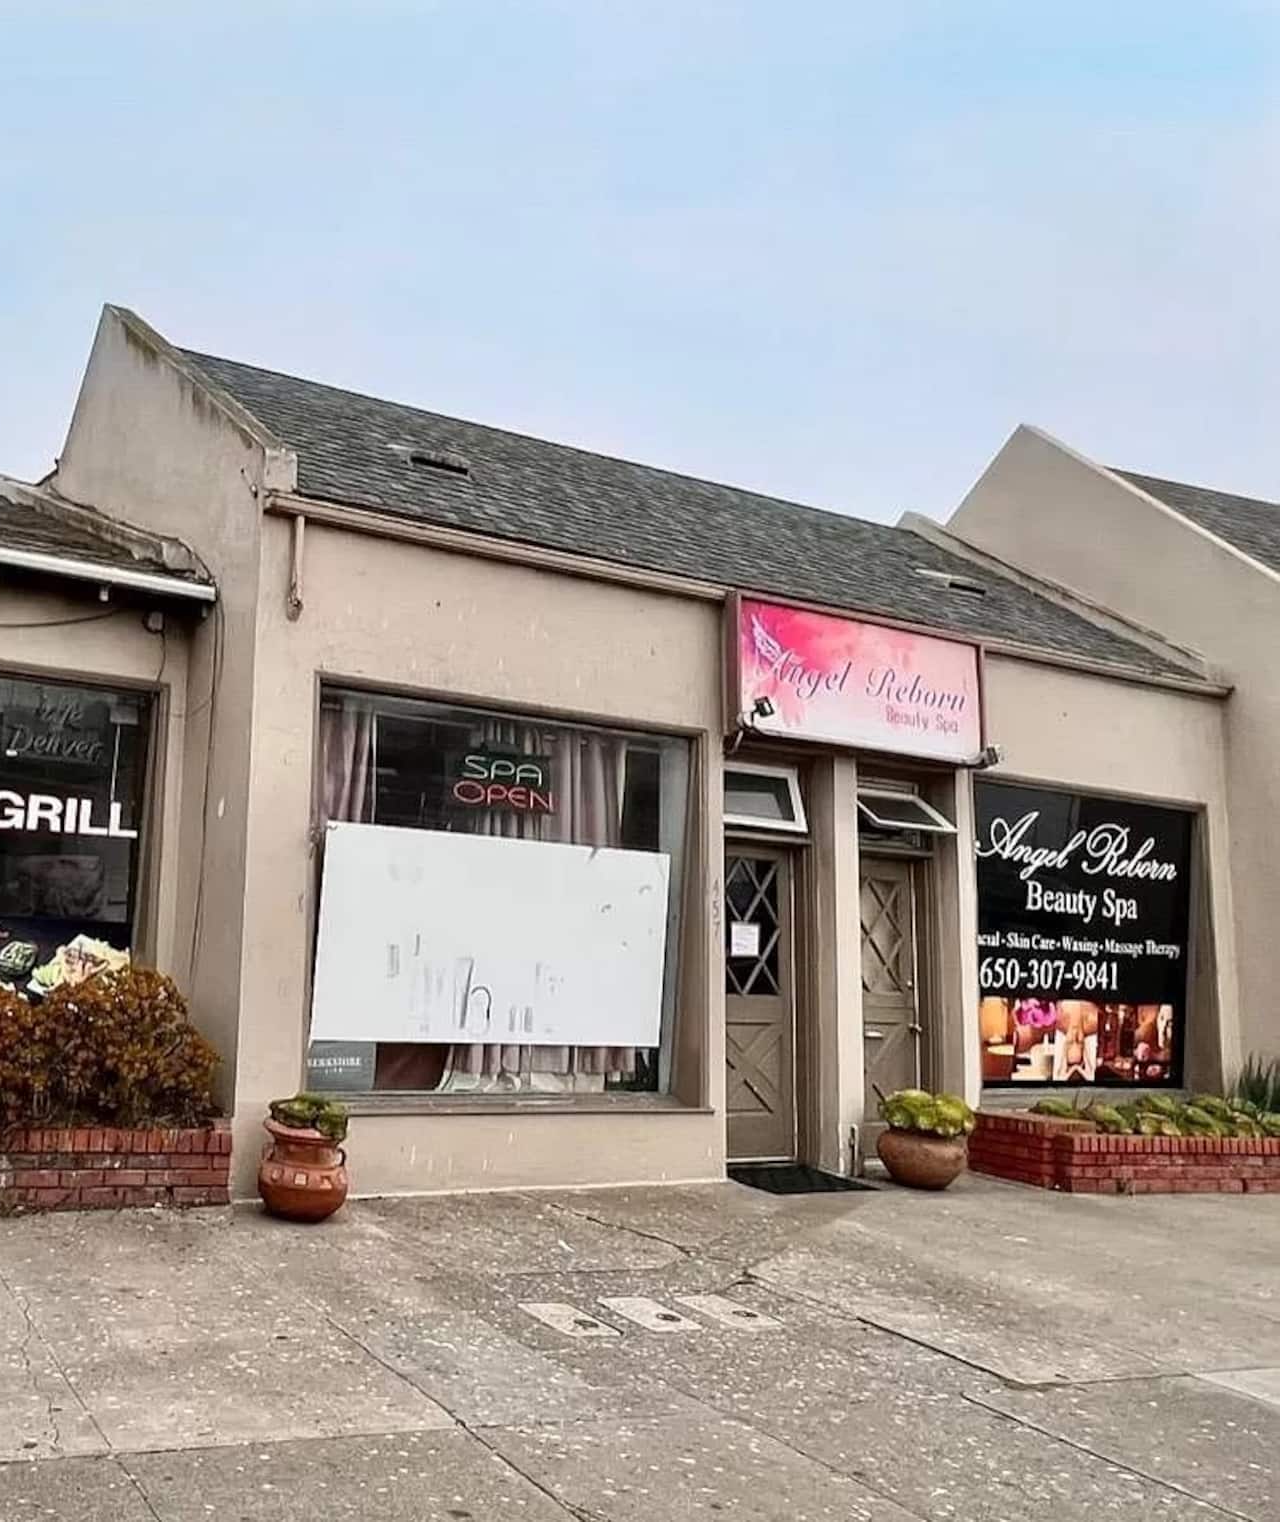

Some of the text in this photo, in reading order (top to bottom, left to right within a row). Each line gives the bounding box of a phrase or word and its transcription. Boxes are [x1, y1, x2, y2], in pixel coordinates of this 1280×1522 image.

[772, 650, 966, 712] Angel Reborn
[886, 706, 959, 733] Beauty Spa
[462, 755, 542, 786] SPA
[453, 780, 553, 812] OPEN
[975, 811, 1177, 880] Angel Reborn
[1025, 880, 1138, 926] Beauty Spa
[977, 931, 1000, 947] acial
[979, 956, 1119, 990] 650-307-9841
